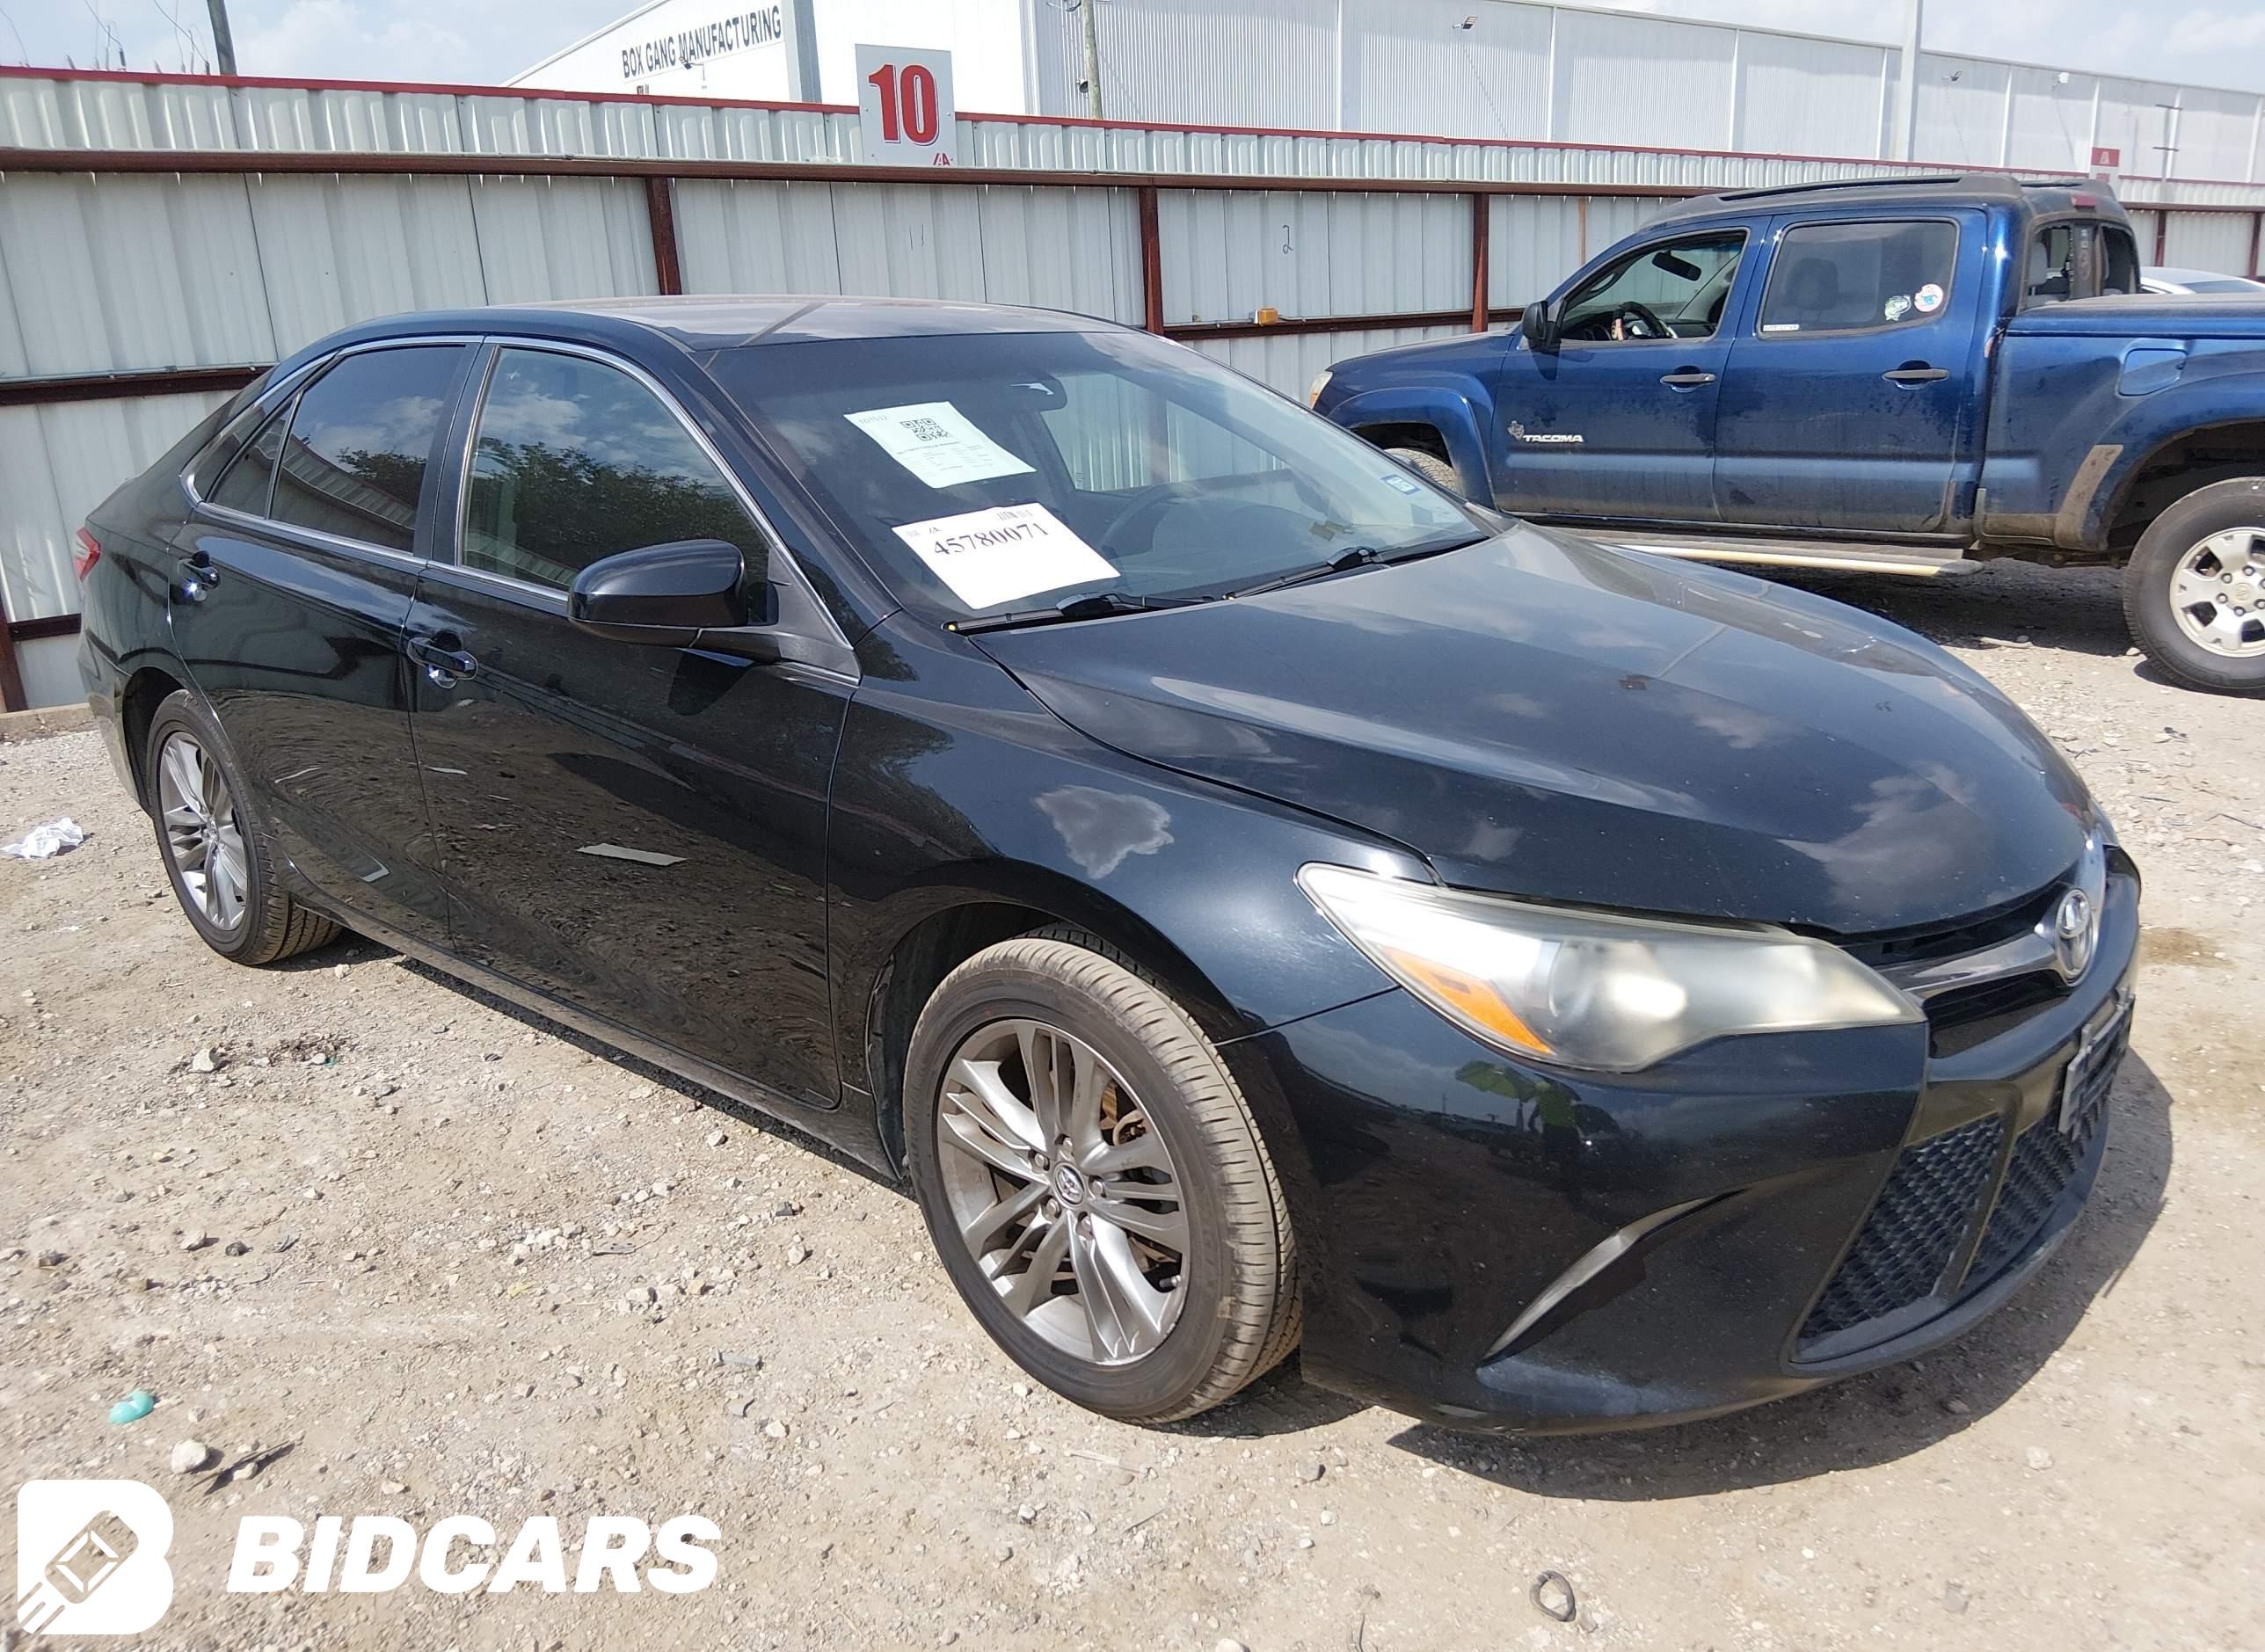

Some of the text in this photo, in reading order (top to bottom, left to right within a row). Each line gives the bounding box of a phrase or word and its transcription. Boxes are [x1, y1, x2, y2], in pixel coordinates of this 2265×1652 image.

[622, 5, 782, 78] BOX GANG MANUFACTURING
[867, 63, 940, 147] 10
[1522, 434, 1584, 443] TACOMA
[934, 522, 1049, 555] 45780071
